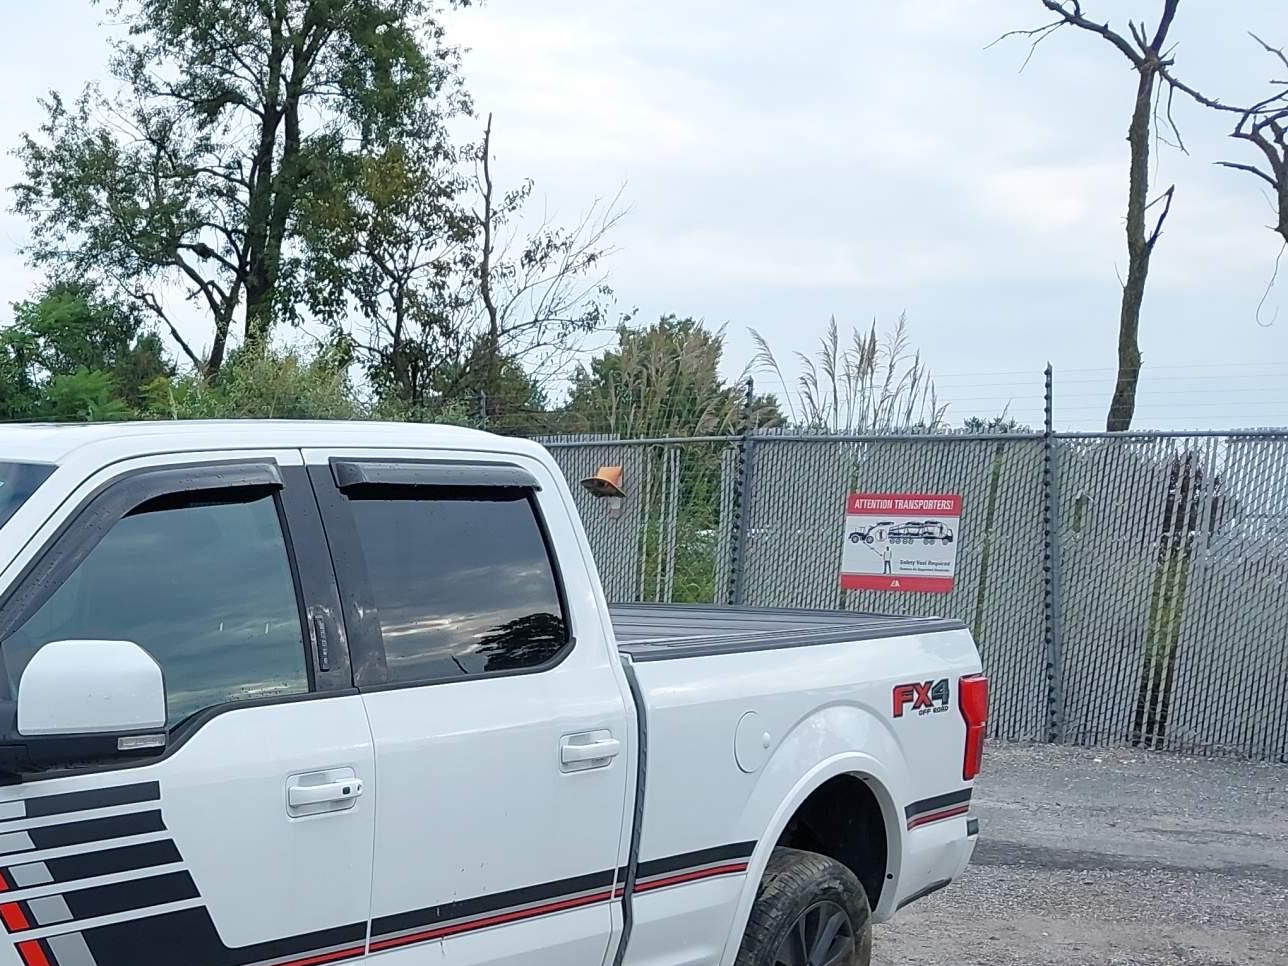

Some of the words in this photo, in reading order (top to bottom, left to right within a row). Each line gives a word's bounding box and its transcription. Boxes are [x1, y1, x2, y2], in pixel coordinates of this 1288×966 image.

[854, 499, 892, 510] ATTENTION
[894, 499, 953, 510] TRANSPORTERS!
[893, 678, 950, 718] FX4
[918, 708, 932, 716] OFF
